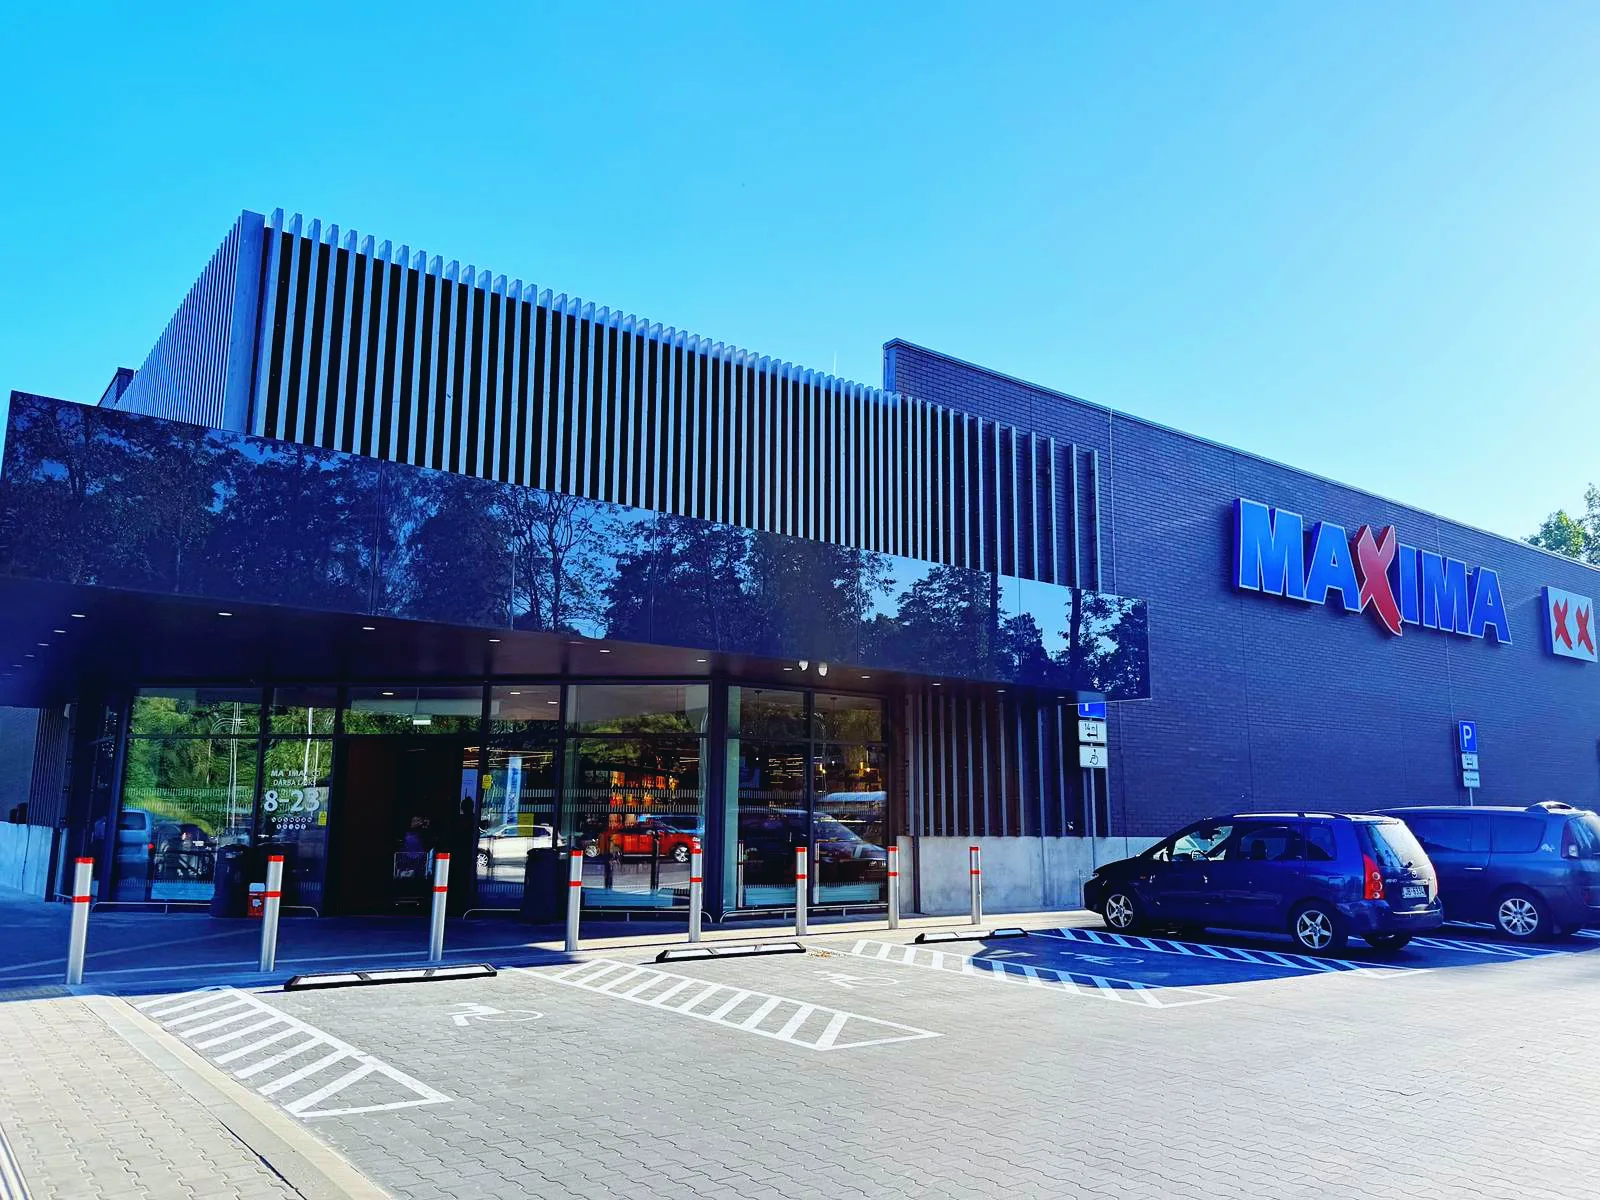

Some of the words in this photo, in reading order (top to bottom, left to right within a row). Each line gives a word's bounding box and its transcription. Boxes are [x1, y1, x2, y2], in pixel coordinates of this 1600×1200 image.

[1236, 498, 1512, 644] MAXIMA
[1462, 724, 1472, 748] P
[270, 769, 305, 777] MAIMA
[263, 789, 320, 812] 8-23
